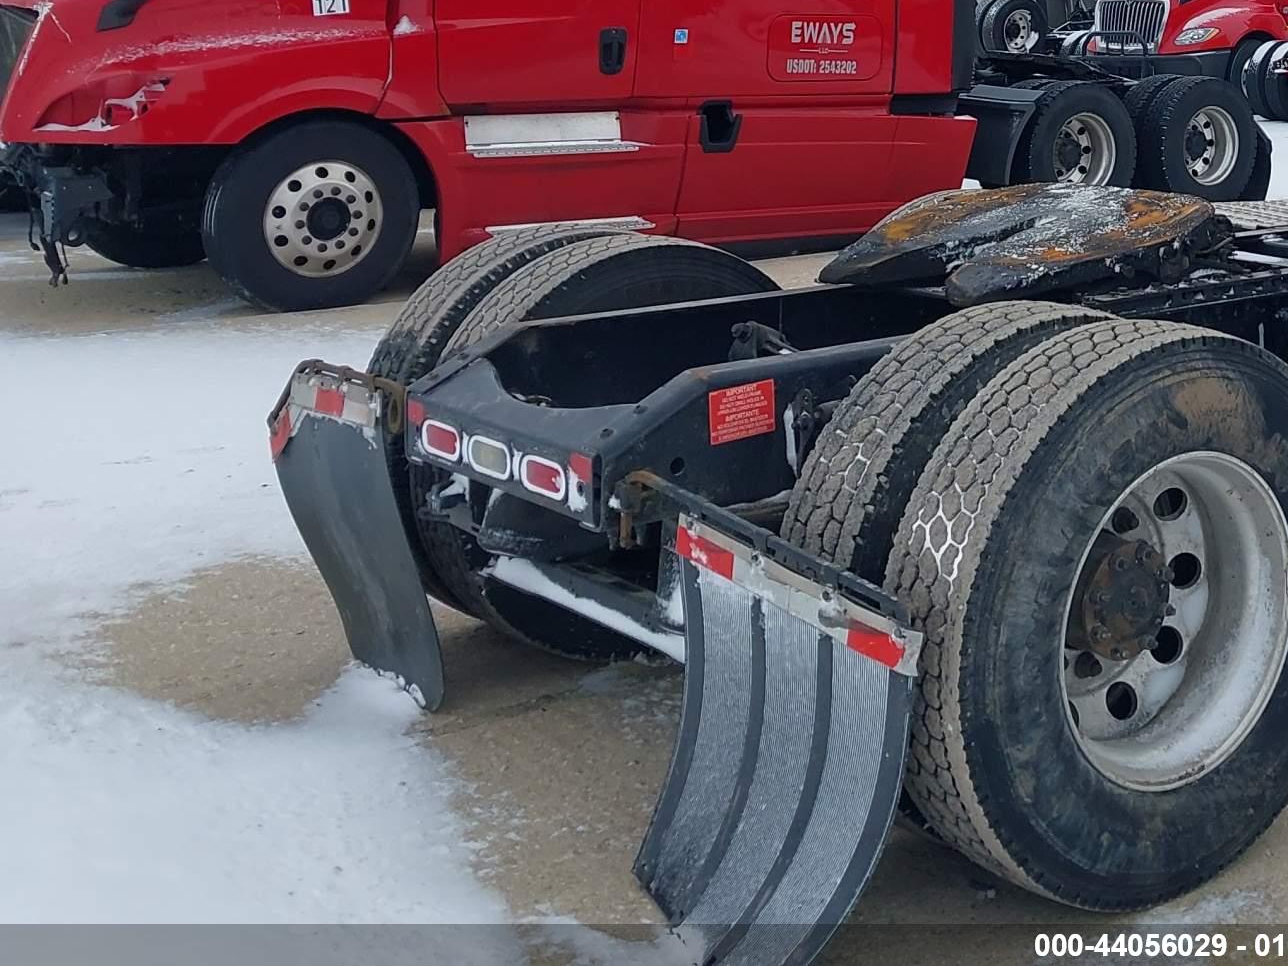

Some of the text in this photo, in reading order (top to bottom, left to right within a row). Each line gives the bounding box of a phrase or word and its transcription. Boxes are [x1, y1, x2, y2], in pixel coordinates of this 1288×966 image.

[791, 21, 856, 44] EWAYS
[786, 58, 857, 74] USDOT: 2543202
